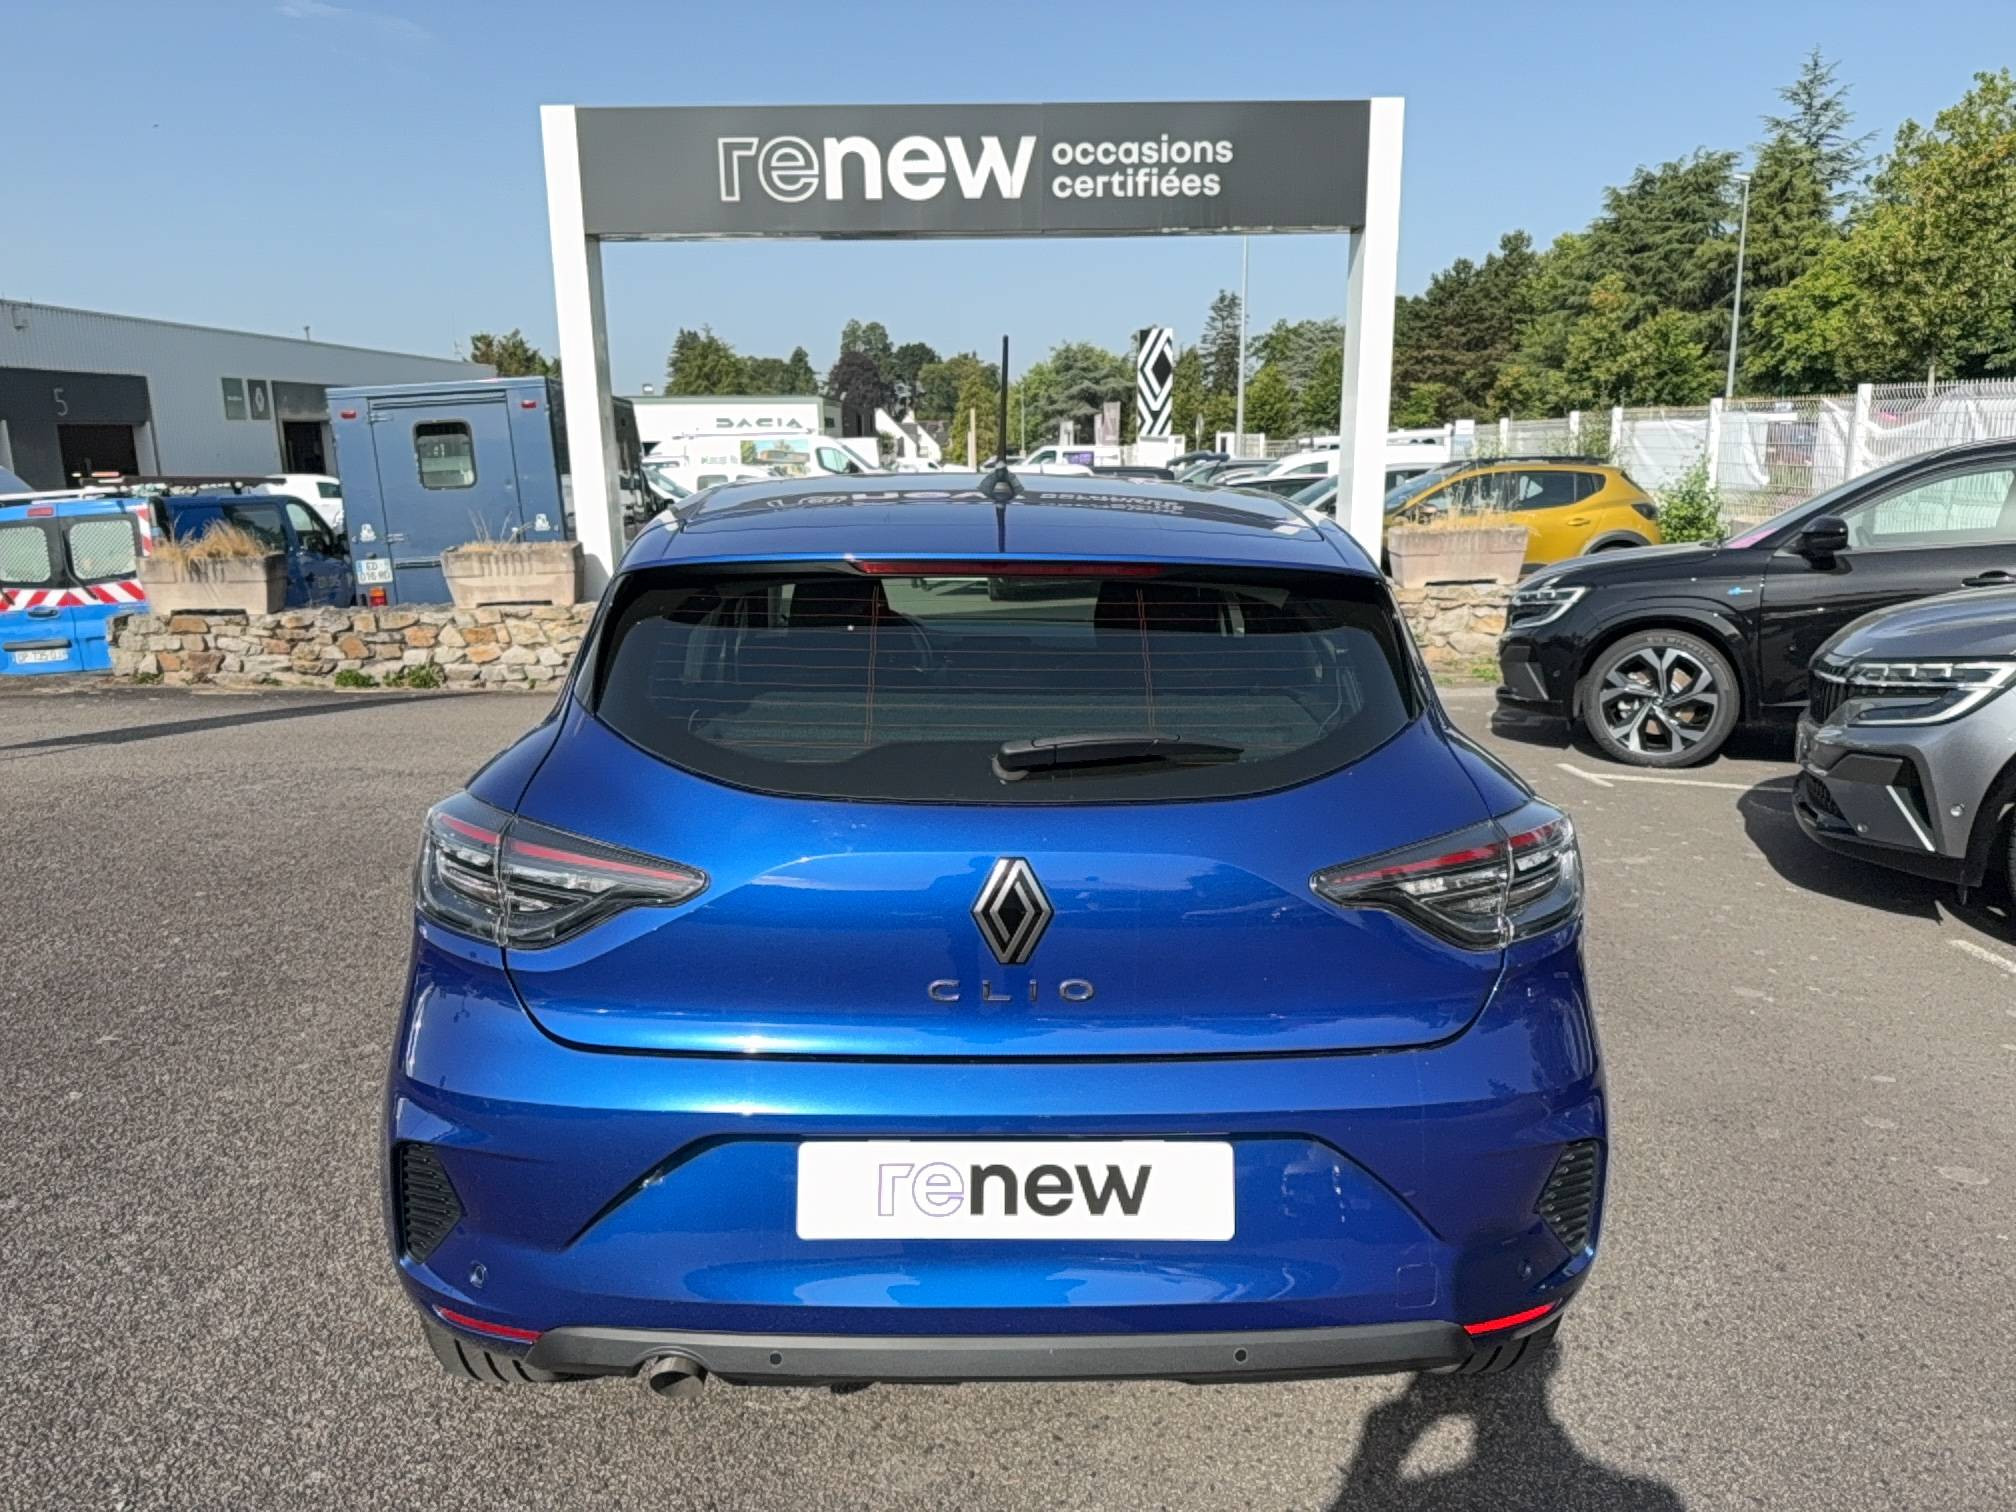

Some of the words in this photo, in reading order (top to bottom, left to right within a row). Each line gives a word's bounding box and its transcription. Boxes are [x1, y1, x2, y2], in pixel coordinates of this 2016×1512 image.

[1052, 134, 1234, 167] occasions
[717, 135, 1037, 203] renew
[1052, 167, 1222, 200] certifiées
[53, 387, 69, 417] 5
[715, 417, 803, 429] DACIA
[927, 978, 1095, 1003] CLIO
[877, 1161, 1153, 1218] renew
